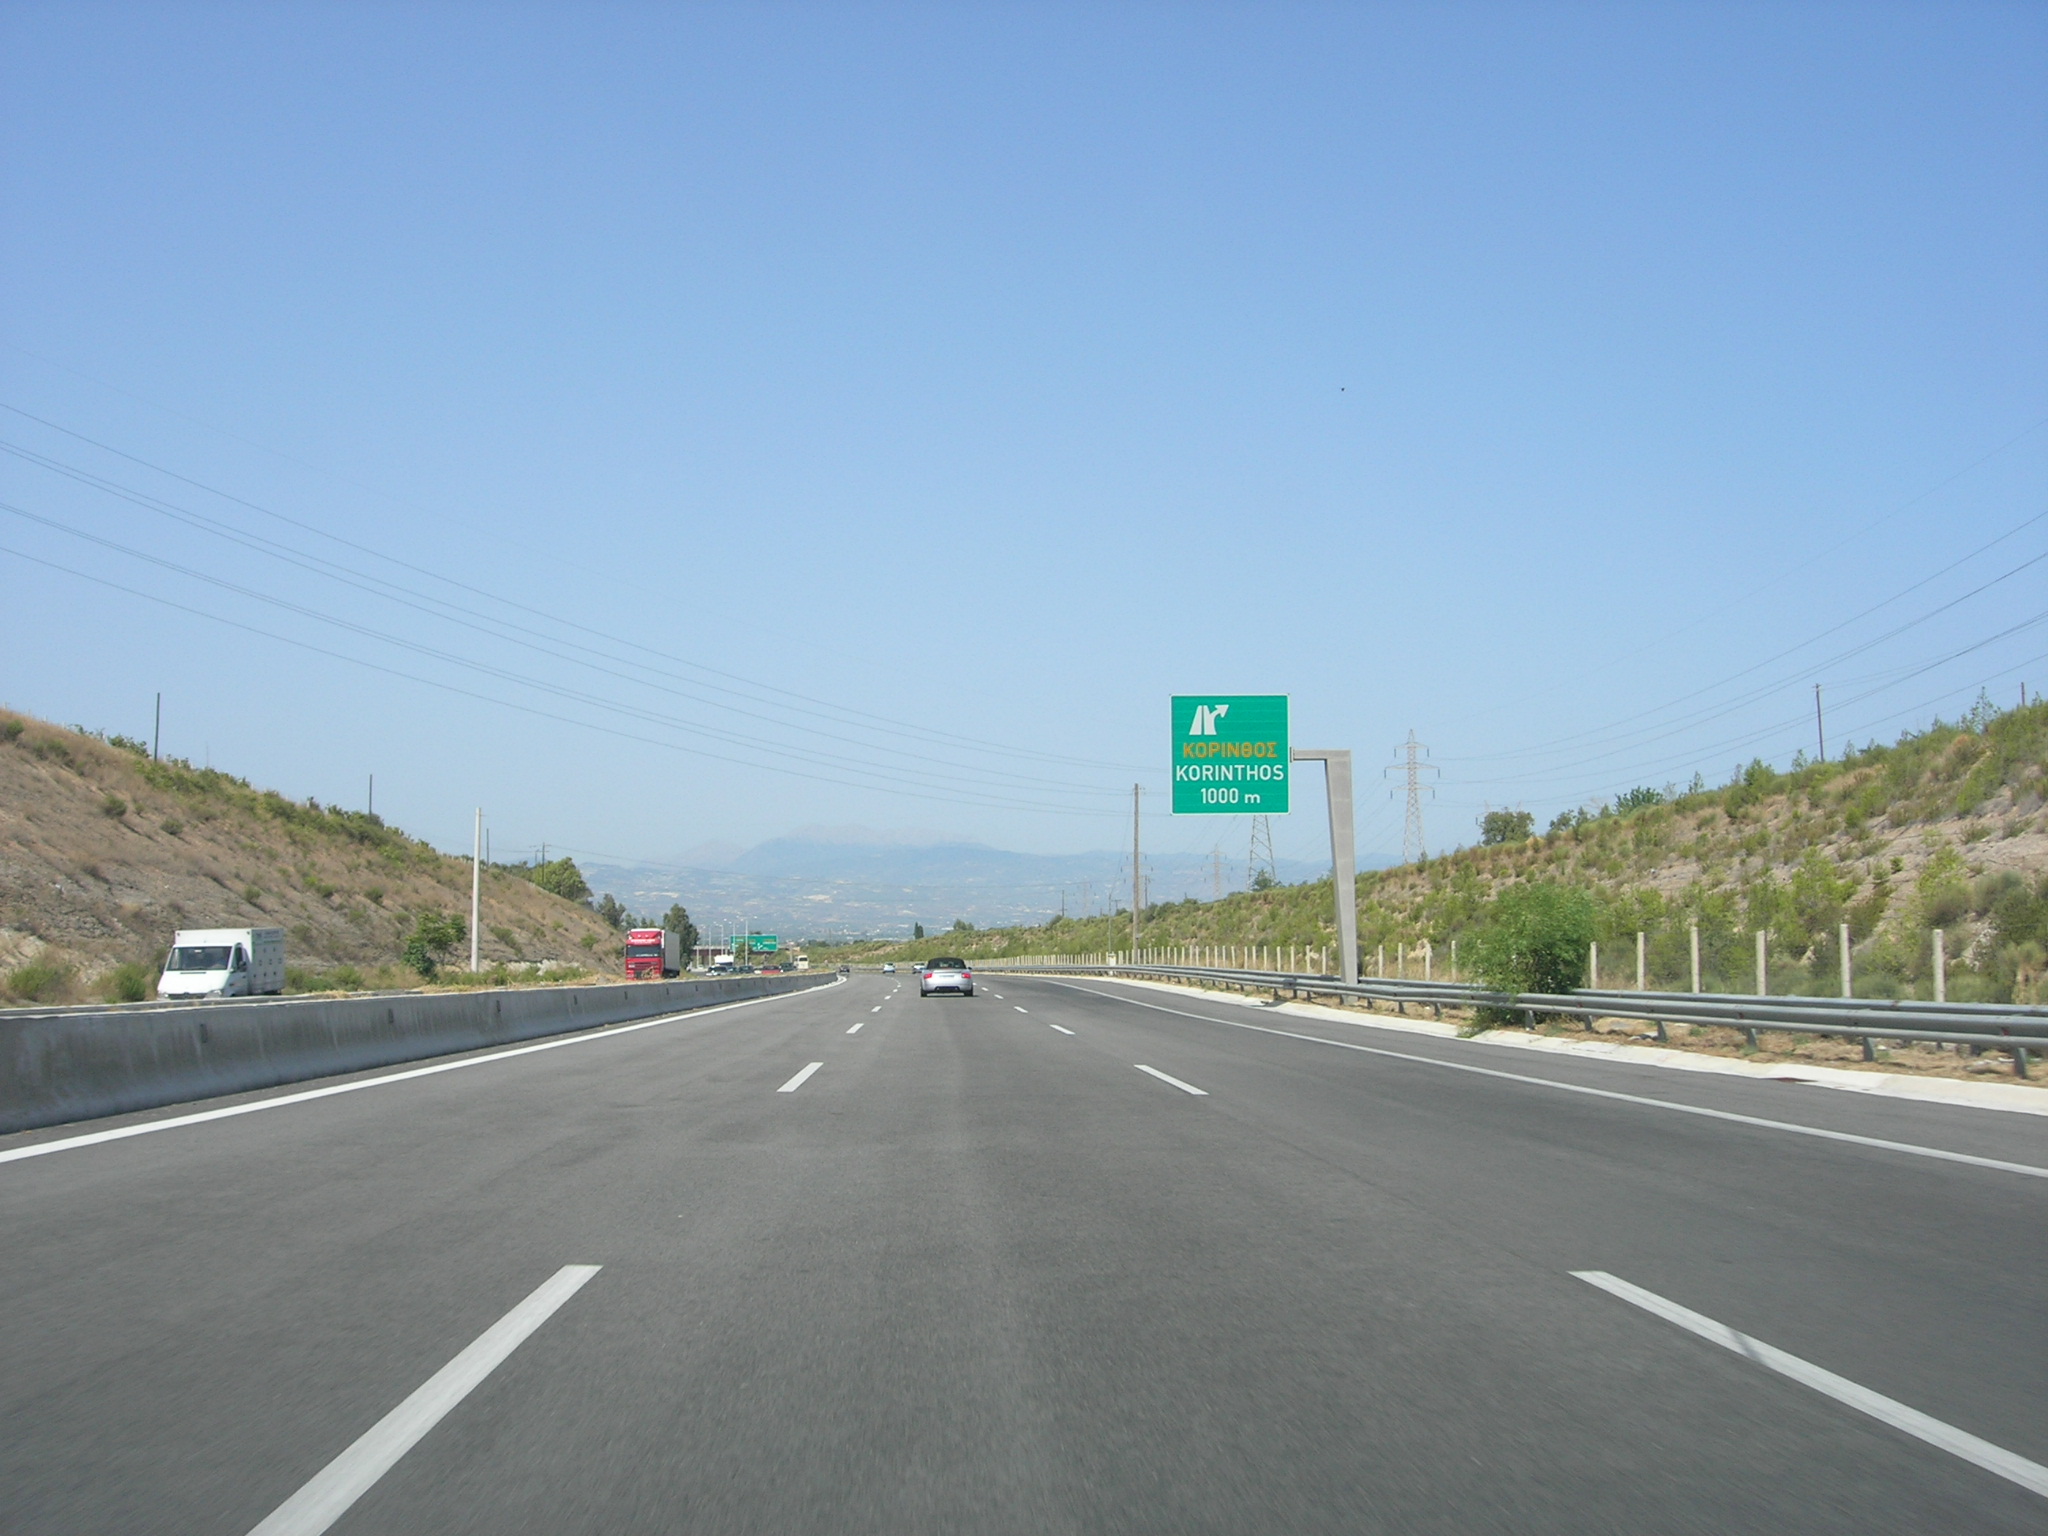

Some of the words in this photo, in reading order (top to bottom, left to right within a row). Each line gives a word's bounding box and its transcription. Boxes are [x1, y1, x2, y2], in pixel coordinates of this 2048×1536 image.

[1183, 742, 1278, 758] ΚΟΡΙΝΘΟΣ
[1176, 765, 1284, 781] KORINTHOS
[1201, 788, 1239, 804] 1000
[1245, 793, 1261, 804] m
